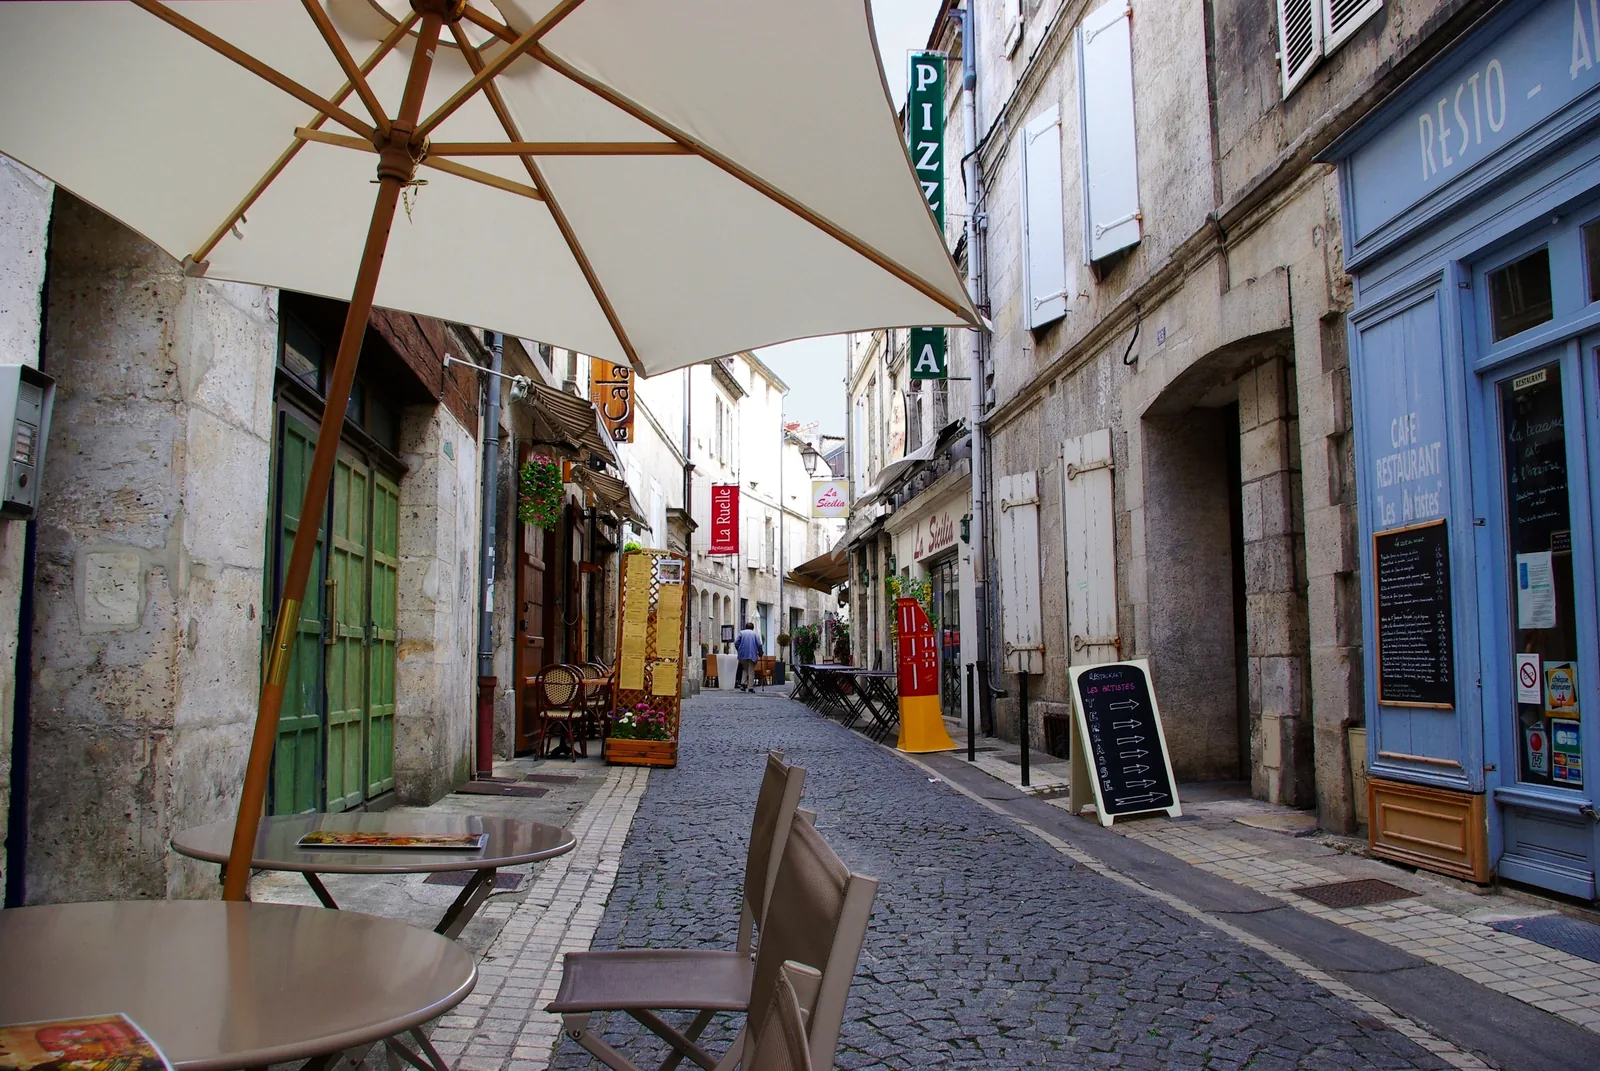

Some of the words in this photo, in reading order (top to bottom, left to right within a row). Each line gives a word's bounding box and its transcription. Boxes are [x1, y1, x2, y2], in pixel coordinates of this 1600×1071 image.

[1419, 58, 1506, 182] RESTO
[1515, 371, 1545, 388] RESTAURANT
[1390, 412, 1417, 448] CAFE
[1376, 441, 1441, 489] RESTAURANT
[816, 498, 845, 508] Sicilia
[823, 487, 838, 497] La
[715, 488, 731, 525] Ruelle
[716, 528, 731, 543] La
[914, 519, 924, 560] La
[928, 511, 954, 553] Sicilia
[1087, 686, 1099, 694] LES
[1102, 682, 1136, 693] ARTISTES
